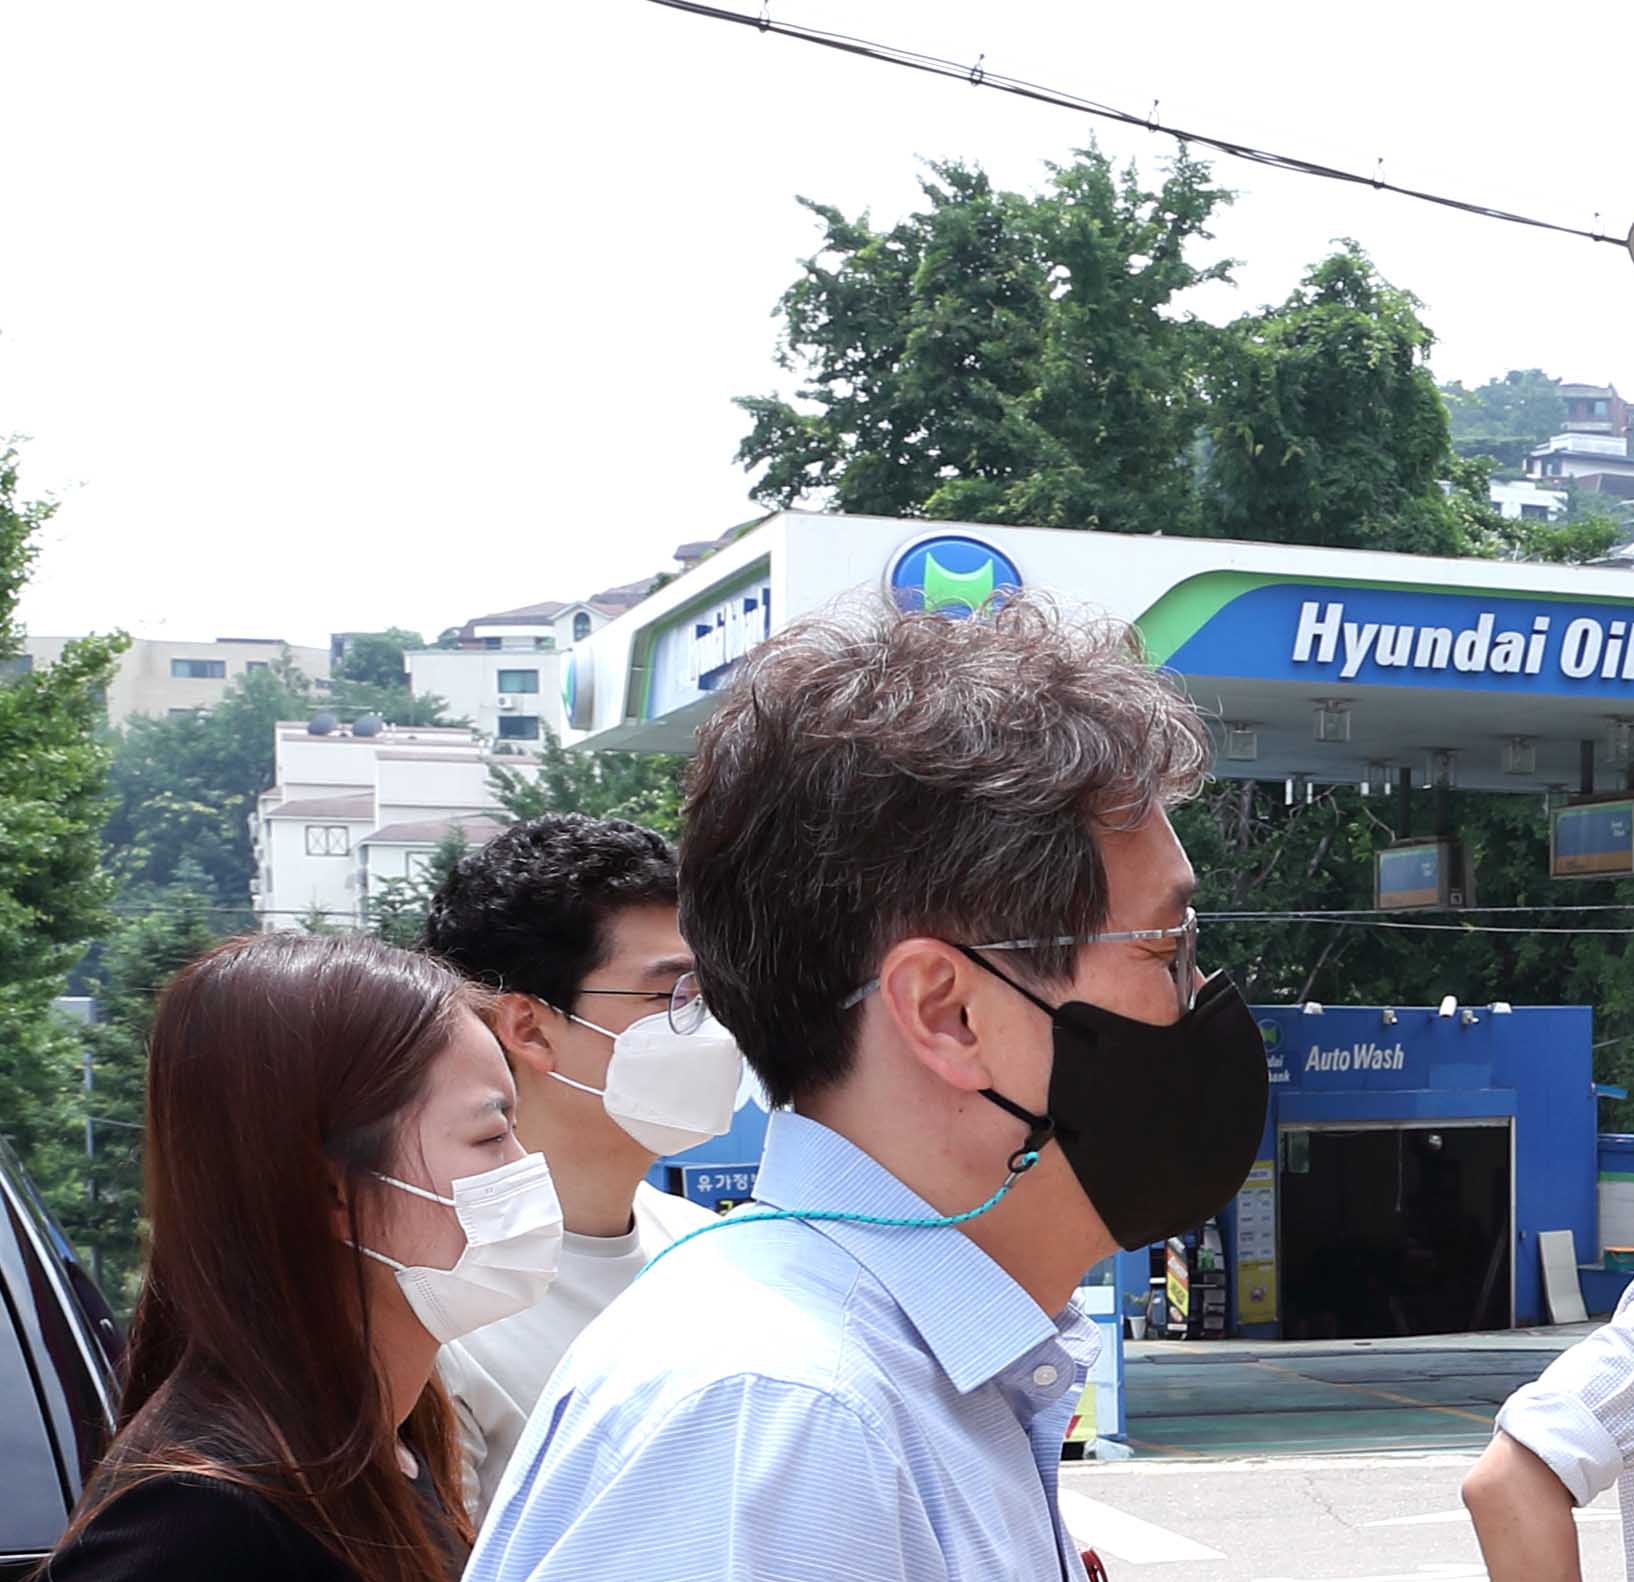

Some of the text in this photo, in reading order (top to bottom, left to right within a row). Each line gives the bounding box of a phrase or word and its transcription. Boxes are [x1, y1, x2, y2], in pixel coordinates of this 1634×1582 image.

[1292, 600, 1550, 678] Hyundai
[1305, 1045, 1350, 1072] Auto
[1353, 1042, 1405, 1069] Wash
